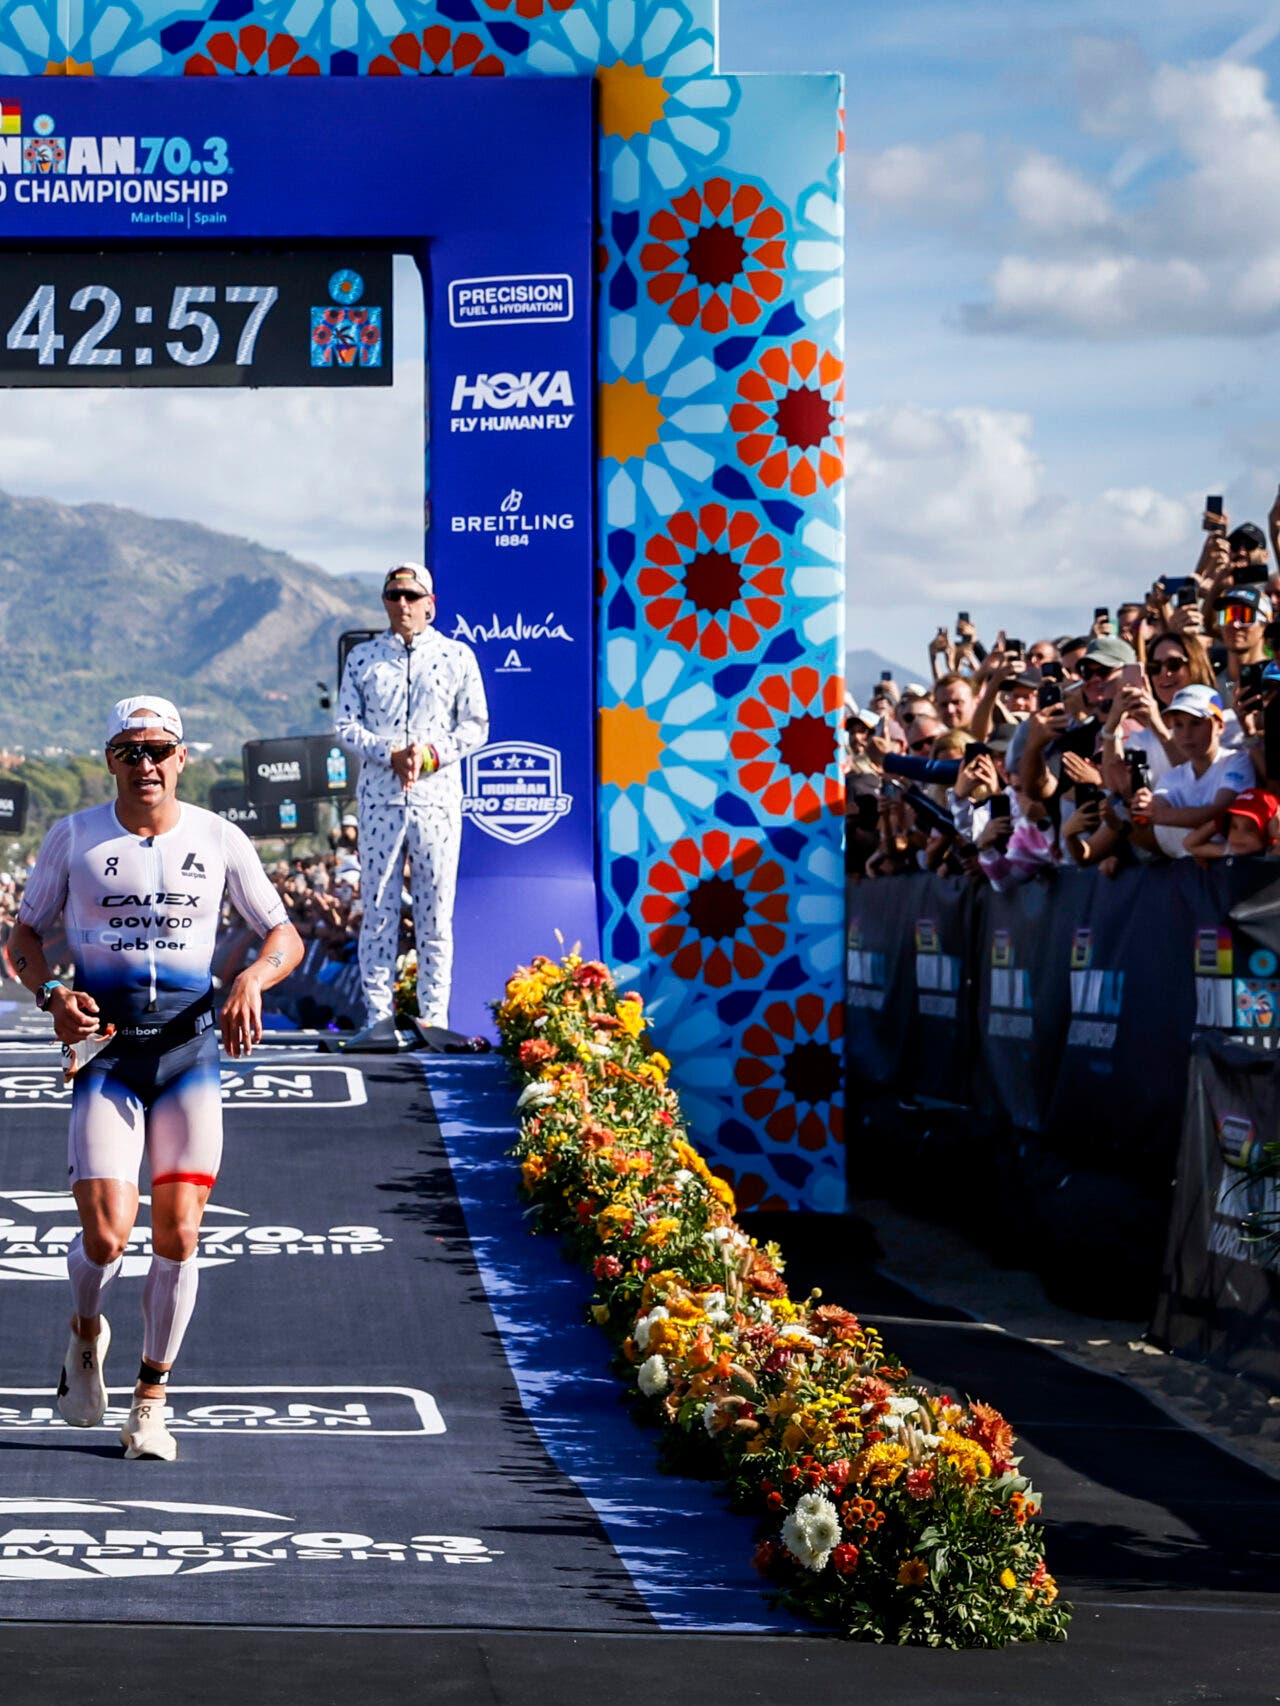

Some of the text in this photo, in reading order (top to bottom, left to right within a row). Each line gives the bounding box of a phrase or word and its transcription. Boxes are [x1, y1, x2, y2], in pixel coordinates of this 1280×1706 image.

[140, 136, 229, 175] 70.3
[14, 180, 228, 204] CHAMPIONSHIP
[131, 212, 227, 224] Marbella Spain
[458, 284, 563, 305] PRECISION
[460, 301, 563, 316] FUEL & HYDRATION
[451, 370, 575, 411] HOKA
[450, 414, 575, 432] FLY HUMAN FLY
[452, 514, 574, 532] BREITLING
[496, 534, 530, 547] 1884
[450, 612, 574, 643] Andalucía
[257, 761, 300, 778] QATAR
[462, 797, 568, 813] PRO SERIES
[102, 892, 200, 908] CADEX
[221, 1532, 489, 1555] 70.3
